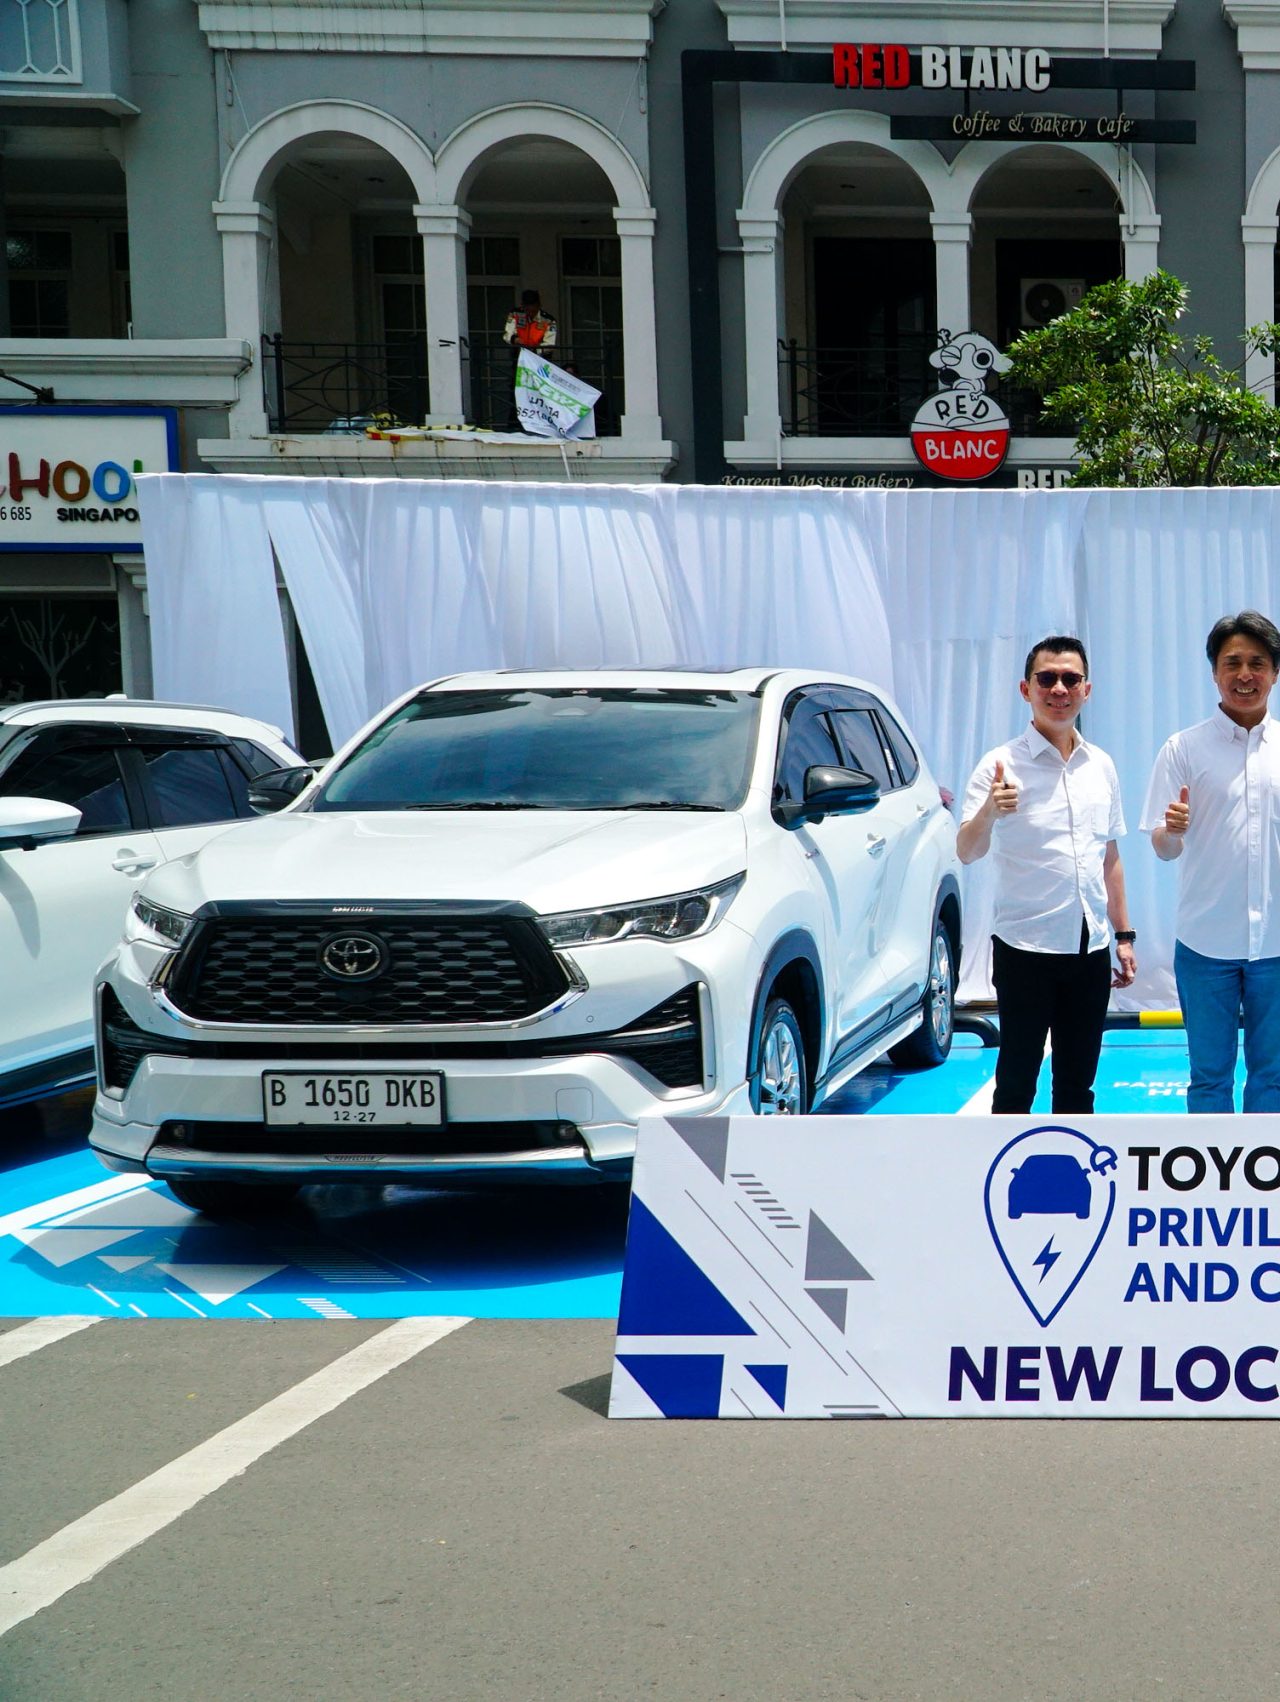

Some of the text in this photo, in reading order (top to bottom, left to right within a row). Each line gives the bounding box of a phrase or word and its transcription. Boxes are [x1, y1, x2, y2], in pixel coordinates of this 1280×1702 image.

[833, 44, 1051, 90] RED BLANC
[952, 111, 1000, 137] Coffee
[1008, 110, 1024, 133] &
[1031, 115, 1087, 139] Bakery
[934, 394, 990, 420] RED
[924, 439, 1000, 460] BLANC
[0, 452, 142, 502] HOO
[721, 473, 914, 489] Korean Master Bakery
[10, 506, 32, 521] 685
[57, 507, 140, 522] SINGAPO
[271, 1079, 436, 1108] B 1650 DKB
[1123, 1262, 1240, 1303] AND
[947, 1345, 1124, 1402] NEW
